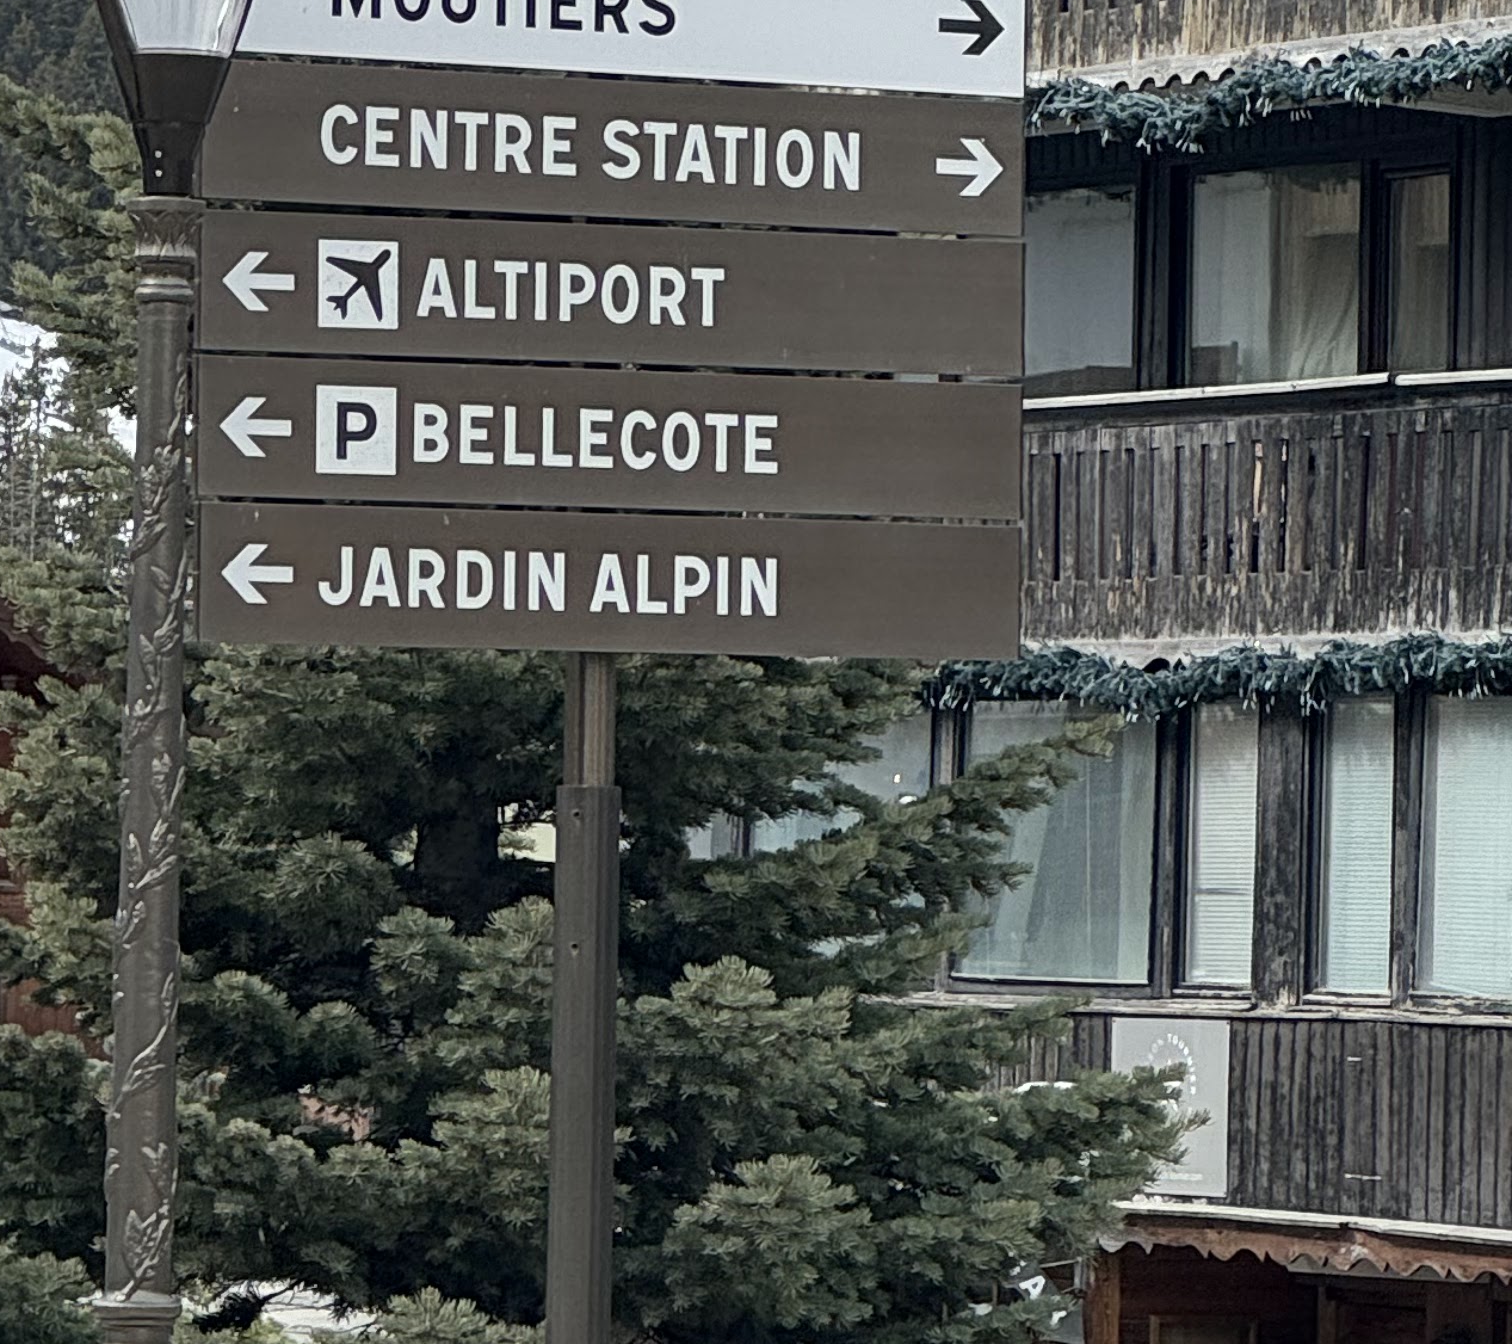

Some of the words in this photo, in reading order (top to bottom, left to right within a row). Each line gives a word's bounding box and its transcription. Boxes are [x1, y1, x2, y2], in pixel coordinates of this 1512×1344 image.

[320, 104, 577, 177] CENTRE
[601, 119, 860, 191] STATION
[416, 257, 725, 327] ALTIPORT
[336, 401, 377, 460] P
[413, 402, 778, 474] BELLECOTE
[318, 546, 565, 612] JARDIN
[589, 553, 778, 617] ALPIN
